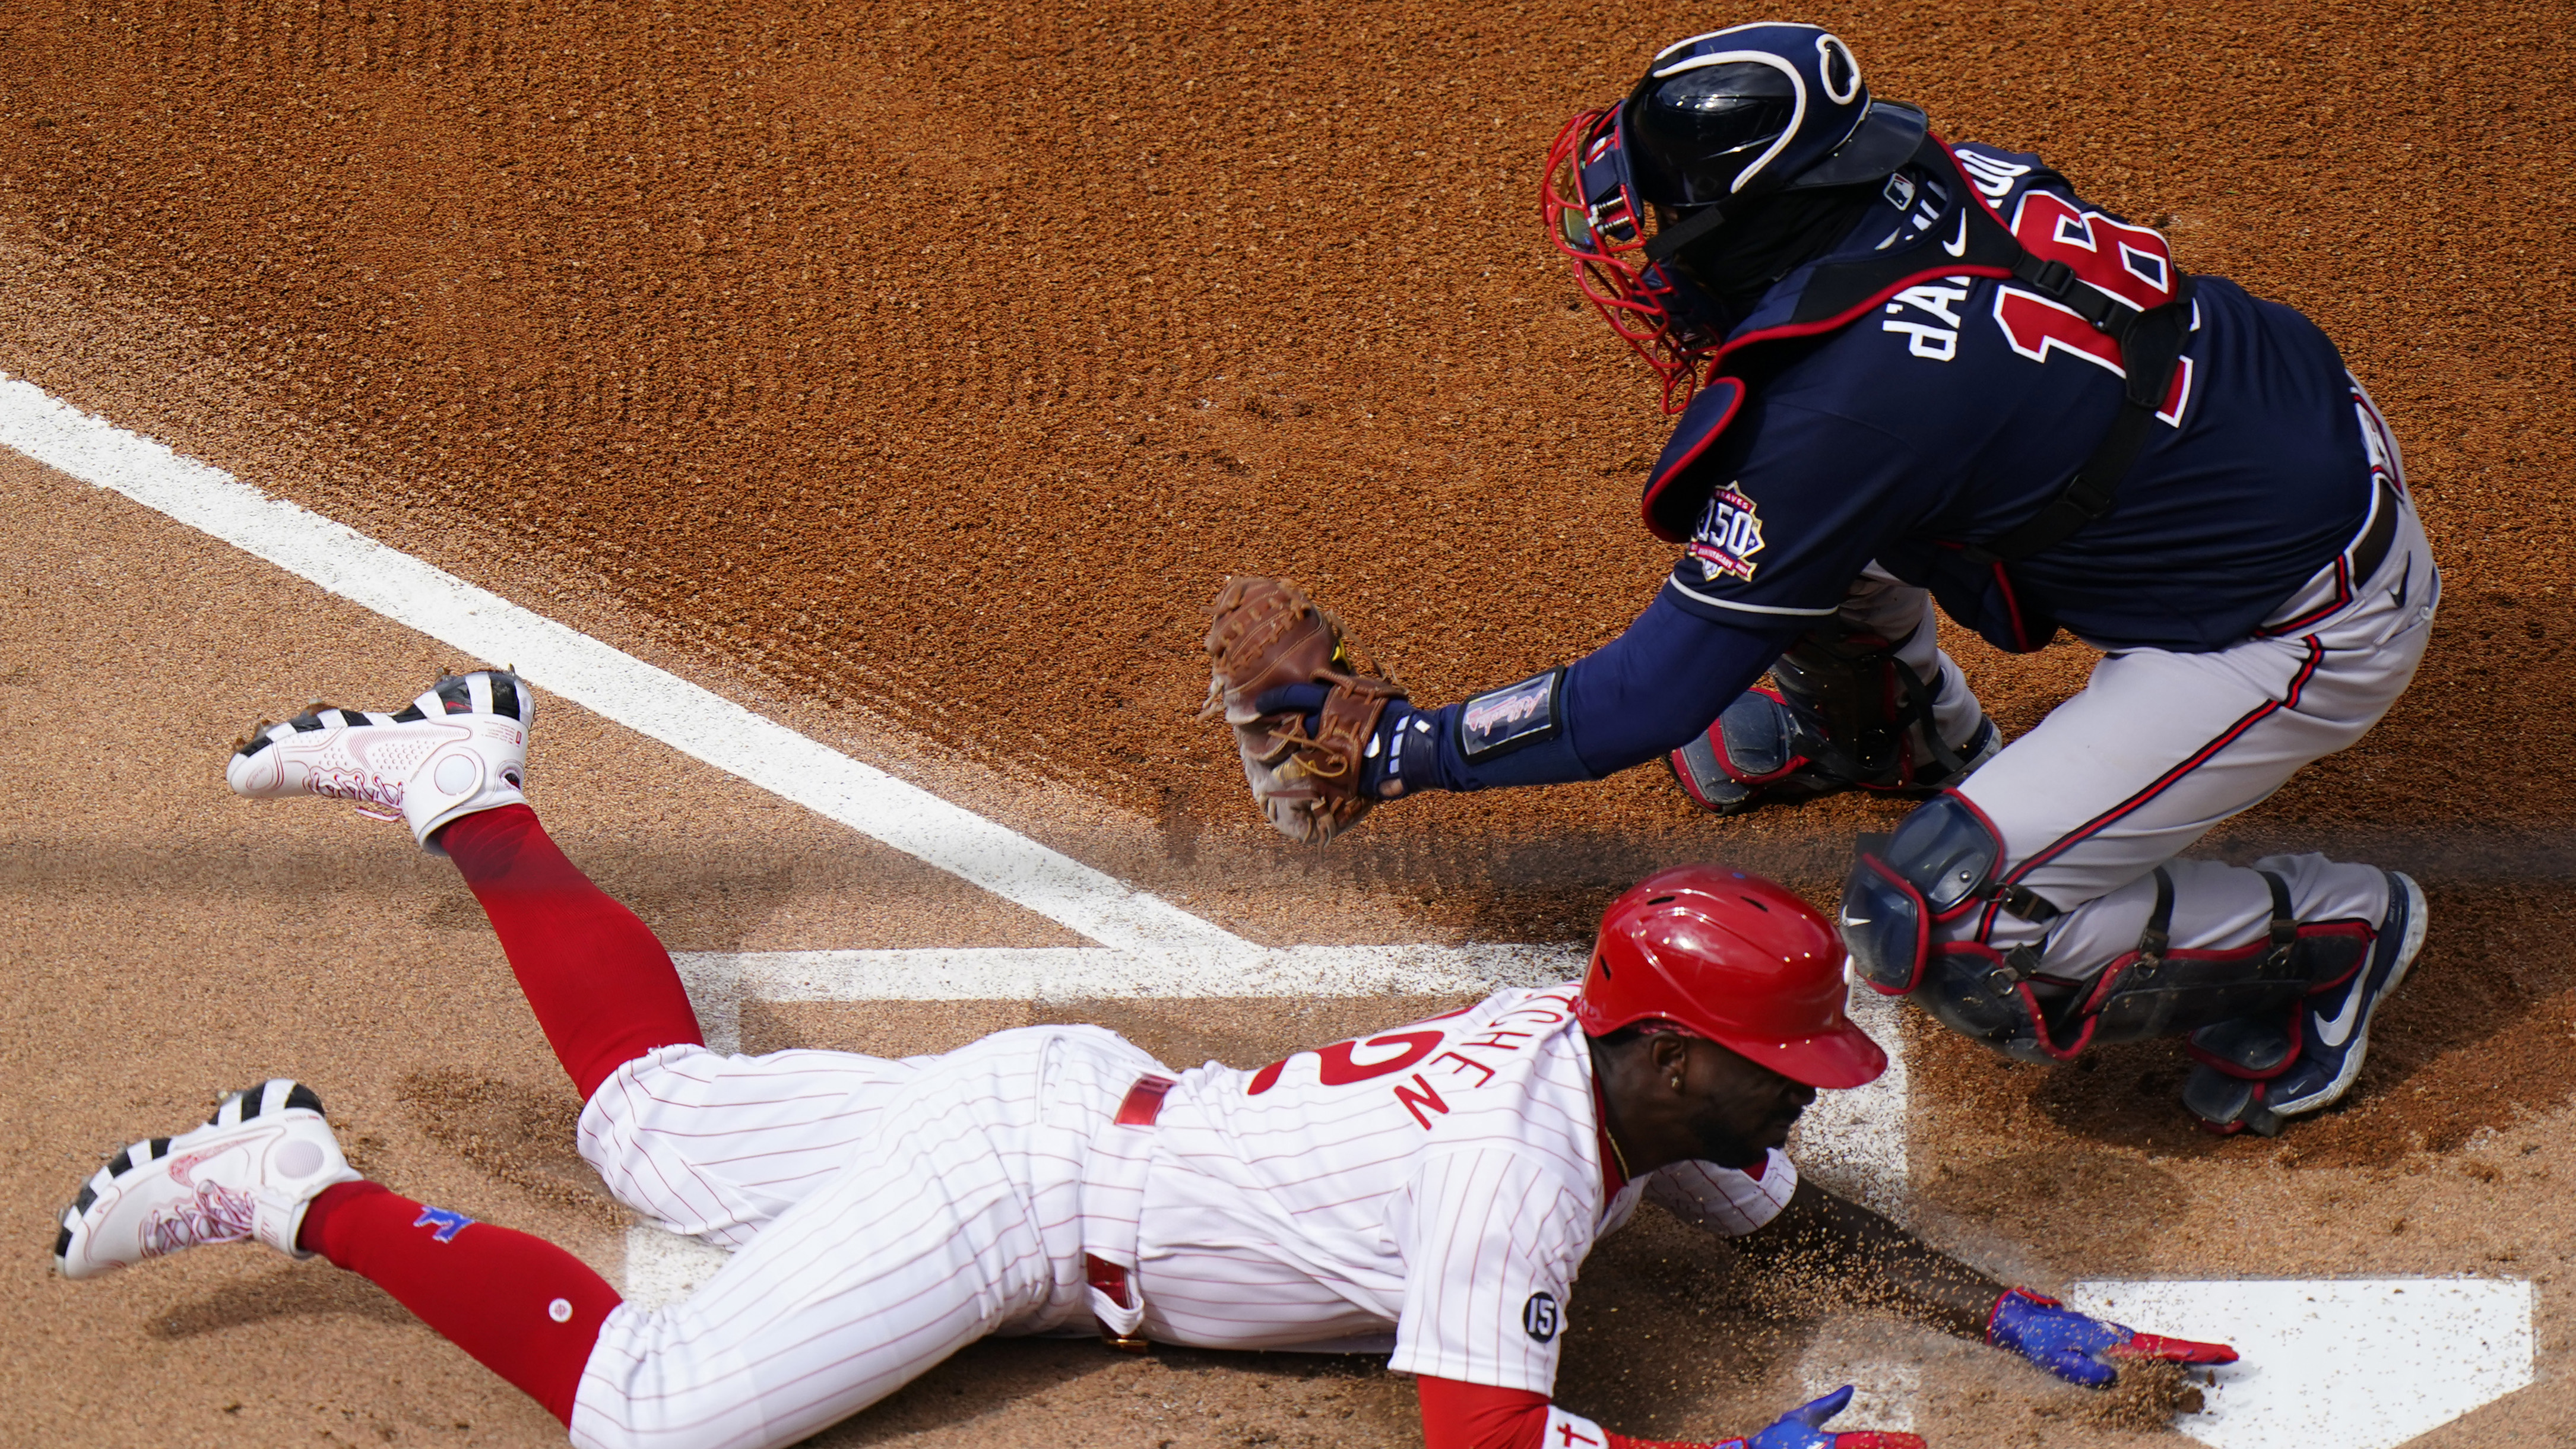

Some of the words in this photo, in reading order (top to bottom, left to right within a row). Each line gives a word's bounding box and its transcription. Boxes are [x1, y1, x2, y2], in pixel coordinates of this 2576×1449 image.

[1993, 189, 2200, 428] 16
[1715, 489, 1749, 511] BRAVES
[1697, 497, 1753, 554] 150
[1528, 1298, 1555, 1336] 15
